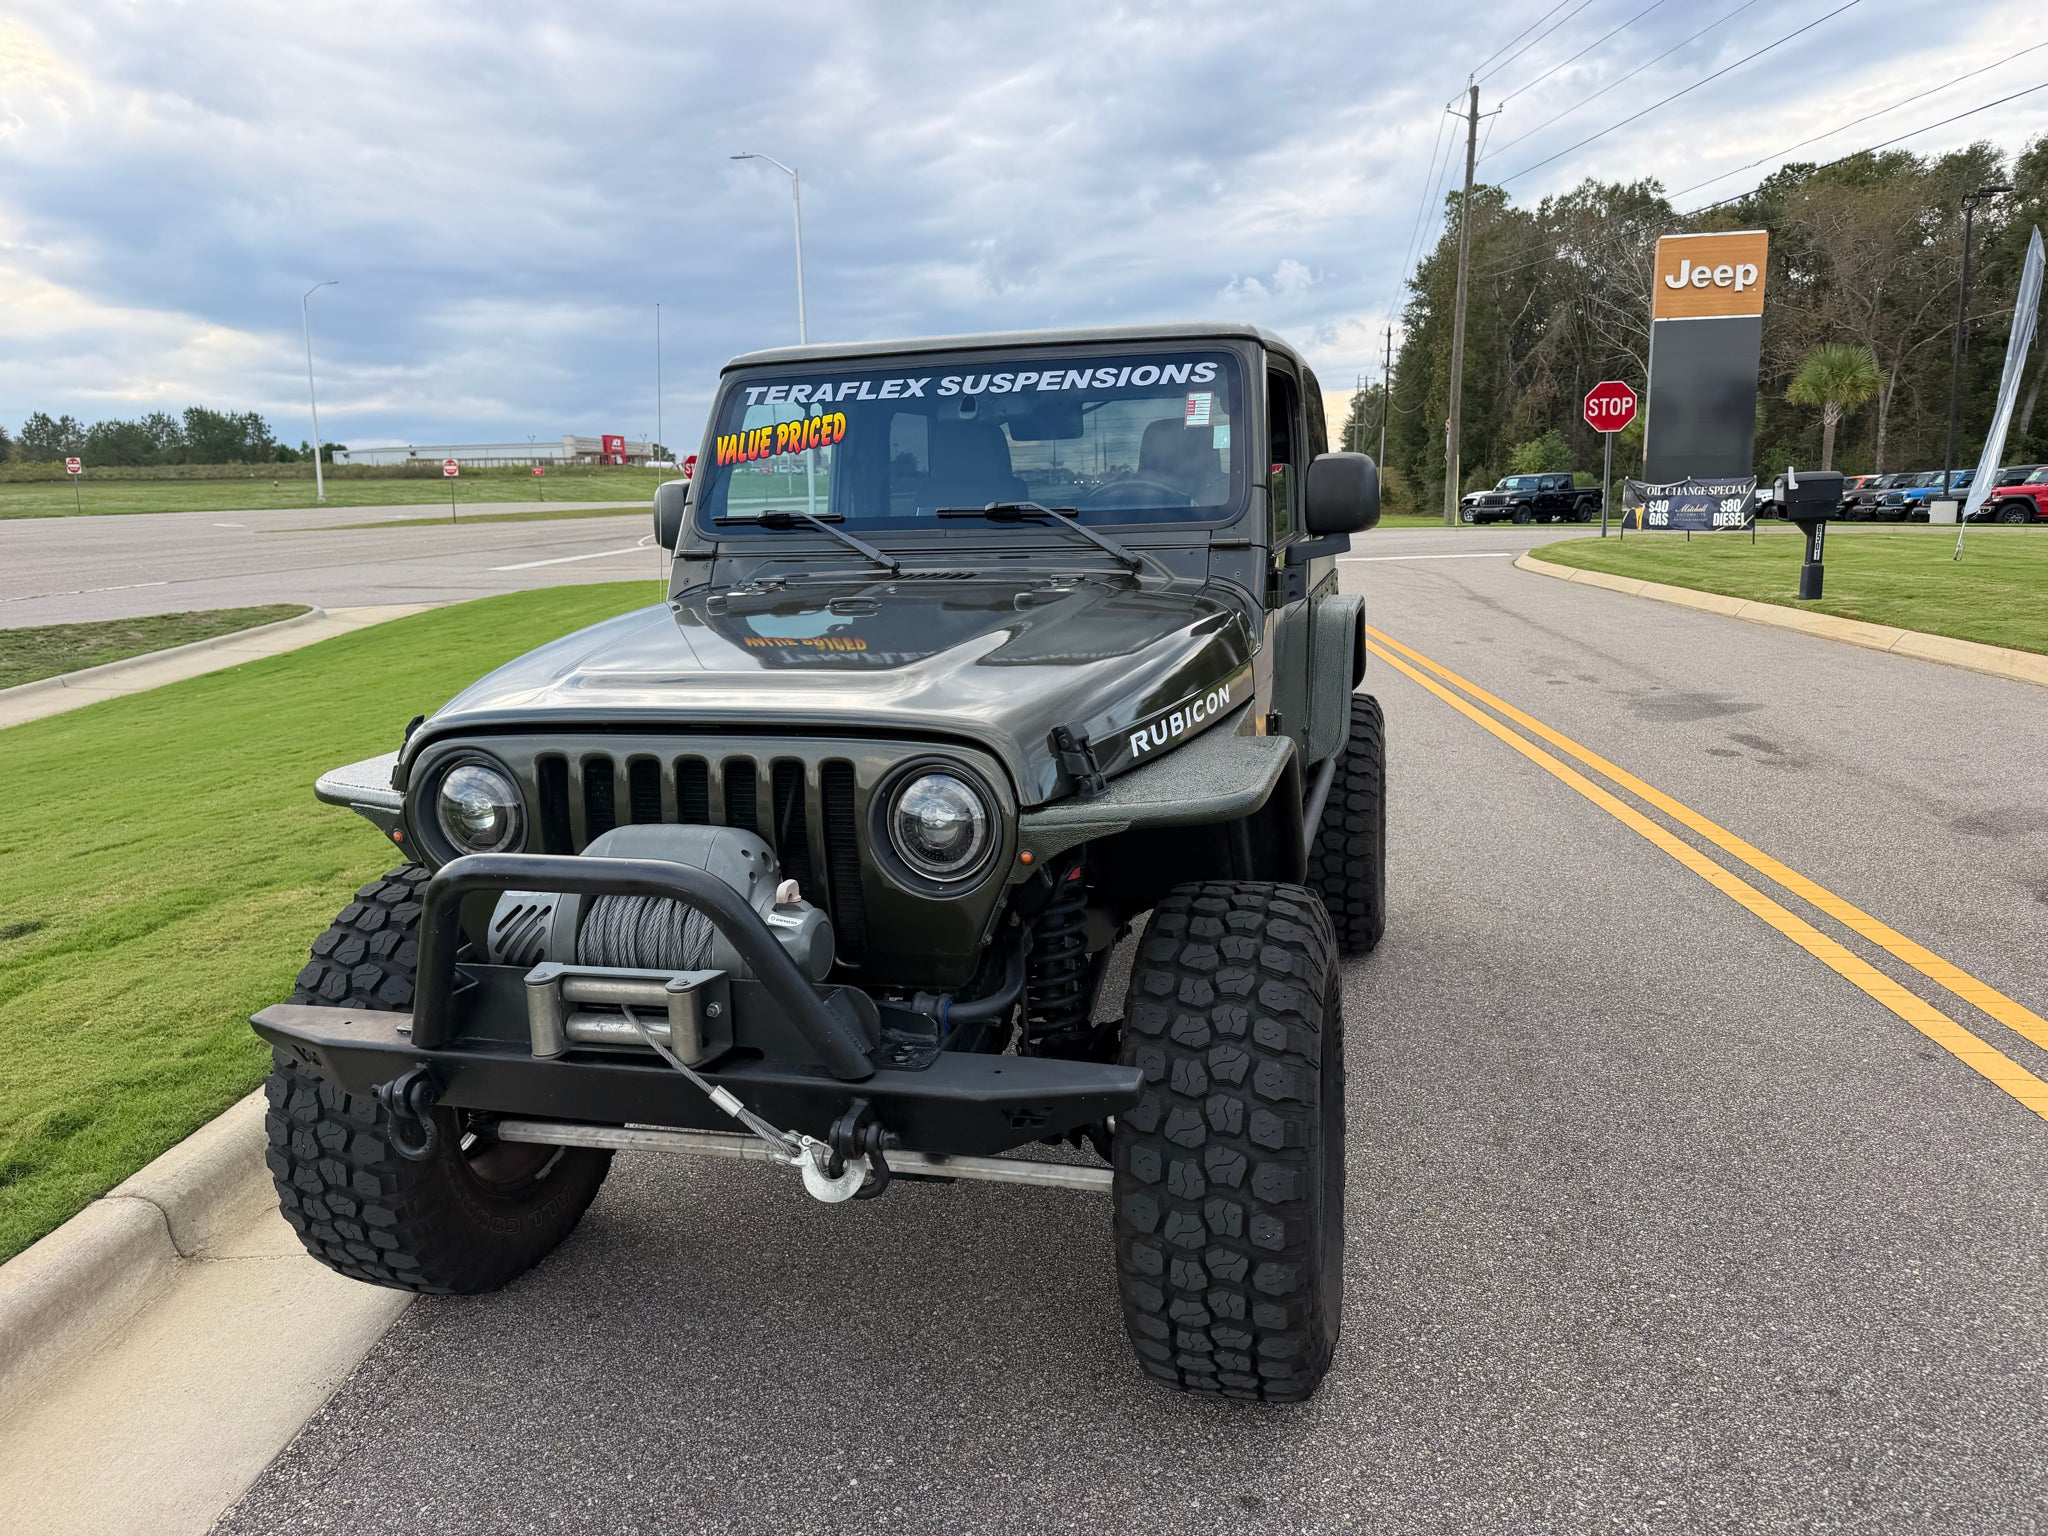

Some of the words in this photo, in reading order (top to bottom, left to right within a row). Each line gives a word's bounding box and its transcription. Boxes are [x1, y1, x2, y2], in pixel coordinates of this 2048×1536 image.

[1665, 259, 1758, 292] Jeep
[745, 378, 932, 405] TERAFLEX
[937, 362, 1218, 396] SUSPENSIONS
[1588, 397, 1633, 416] STOP
[717, 426, 773, 467] VALUE
[776, 412, 846, 454] PRICED
[1647, 486, 1664, 496] OIL
[1665, 486, 1707, 496] CHANGE
[1708, 485, 1749, 495] SPECIAL
[1648, 500, 1669, 512] $40
[1720, 499, 1740, 512] $80
[1649, 513, 1669, 526] GAS
[1712, 512, 1747, 526] DIESEL
[1130, 684, 1230, 758] RUBICON
